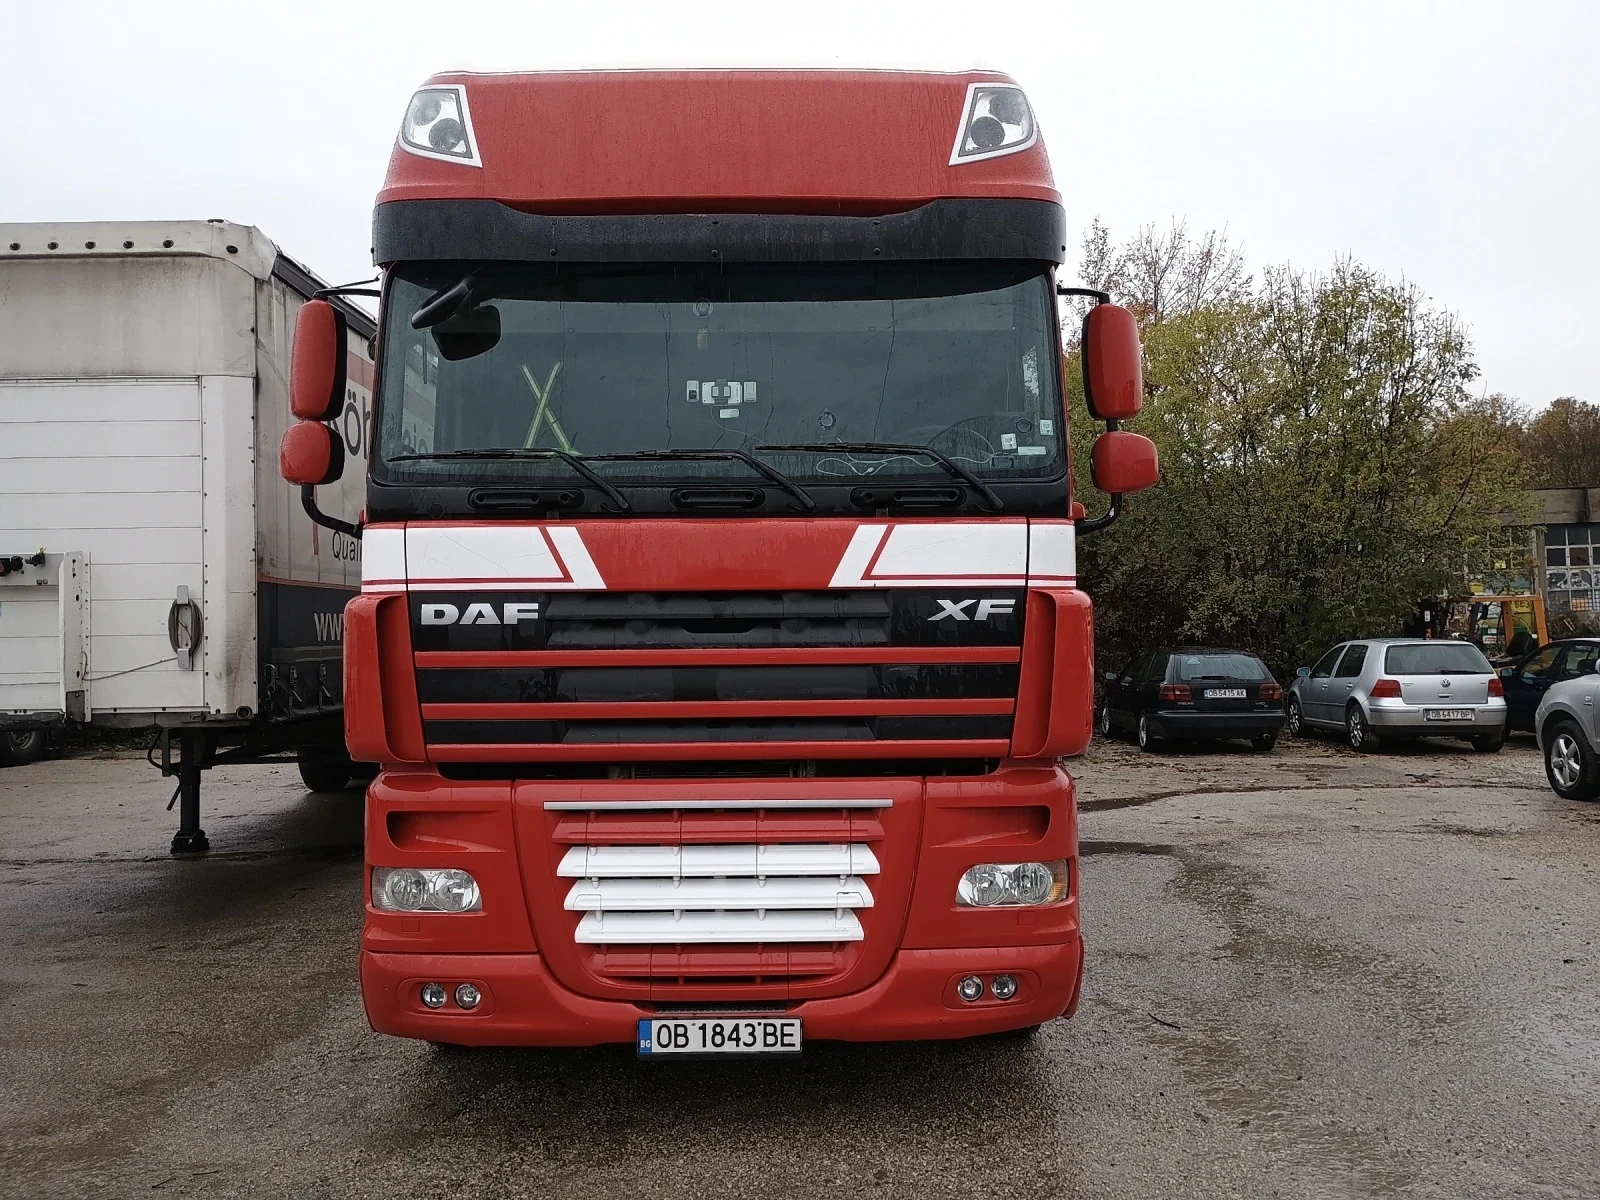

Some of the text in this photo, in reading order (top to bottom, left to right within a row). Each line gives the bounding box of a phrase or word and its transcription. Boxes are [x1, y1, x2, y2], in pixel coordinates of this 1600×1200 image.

[421, 602, 539, 625] DAF
[926, 598, 1016, 621] XF
[640, 1039, 651, 1048] BG
[698, 1022, 757, 1048] 1843
